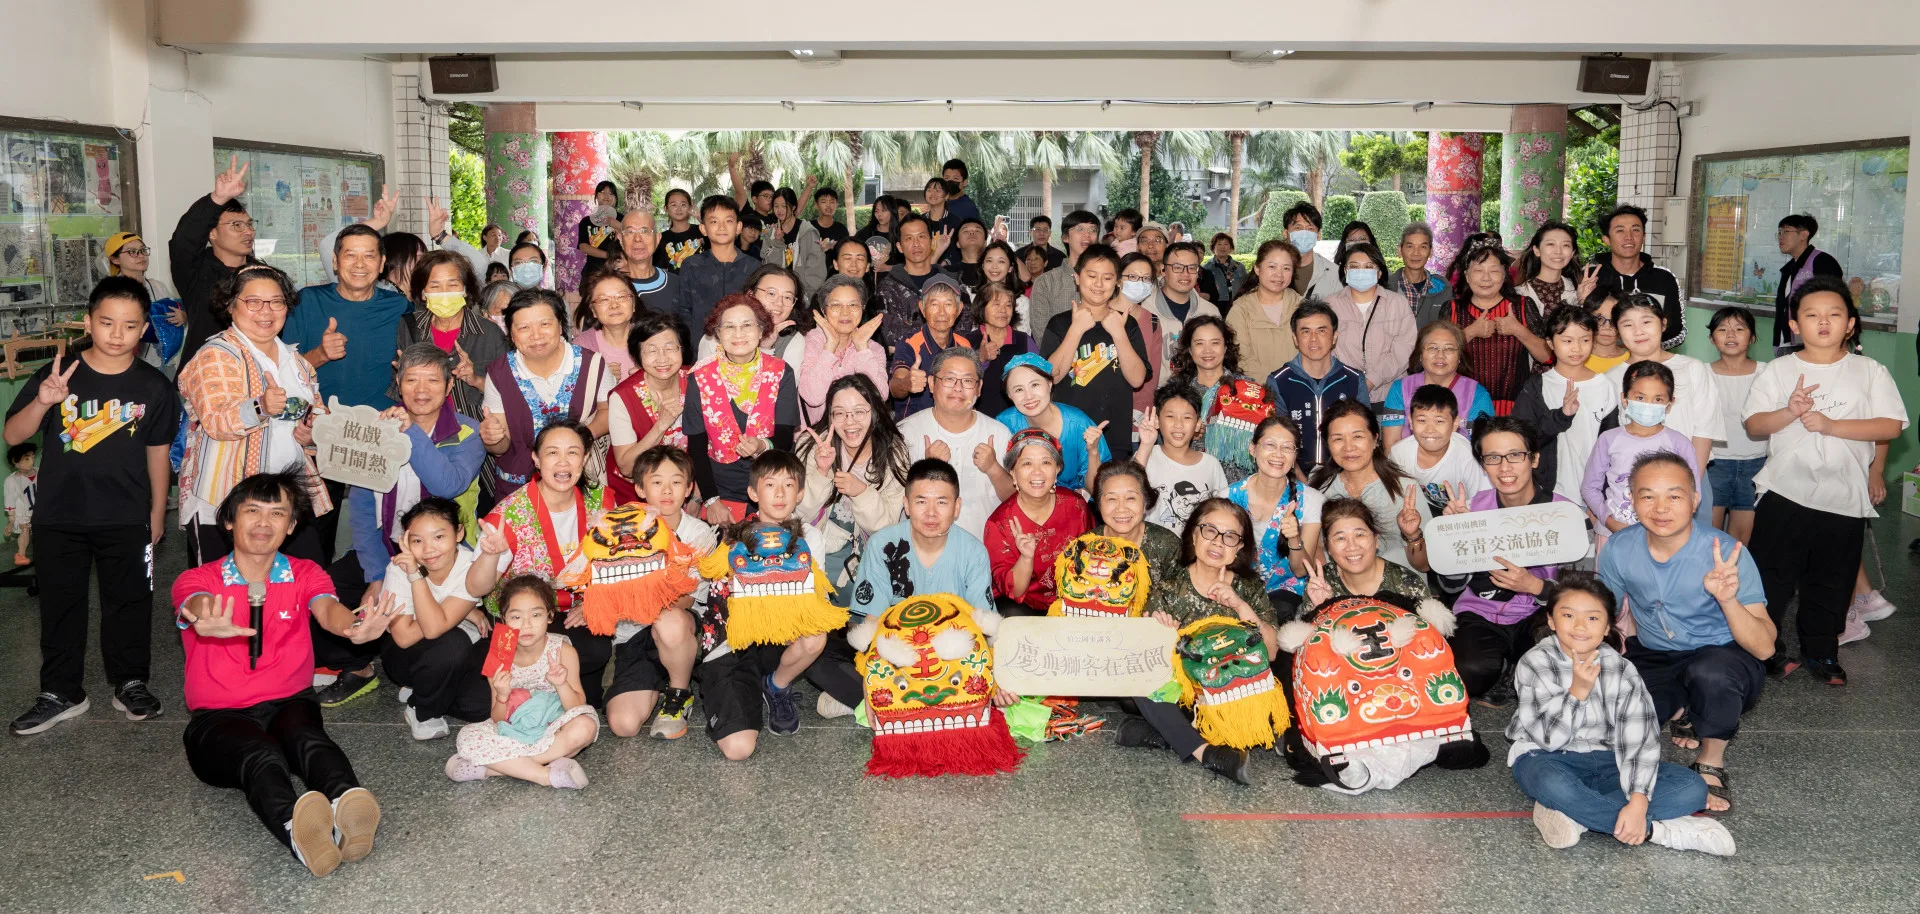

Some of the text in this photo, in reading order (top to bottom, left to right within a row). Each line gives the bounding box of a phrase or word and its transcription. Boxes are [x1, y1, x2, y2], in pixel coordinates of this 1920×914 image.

[61, 393, 146, 428] SUPER
[343, 420, 382, 447] 做戲
[759, 531, 782, 549] 王
[1206, 628, 1236, 651] 王
[1352, 621, 1394, 661] 王
[911, 646, 943, 679] 王
